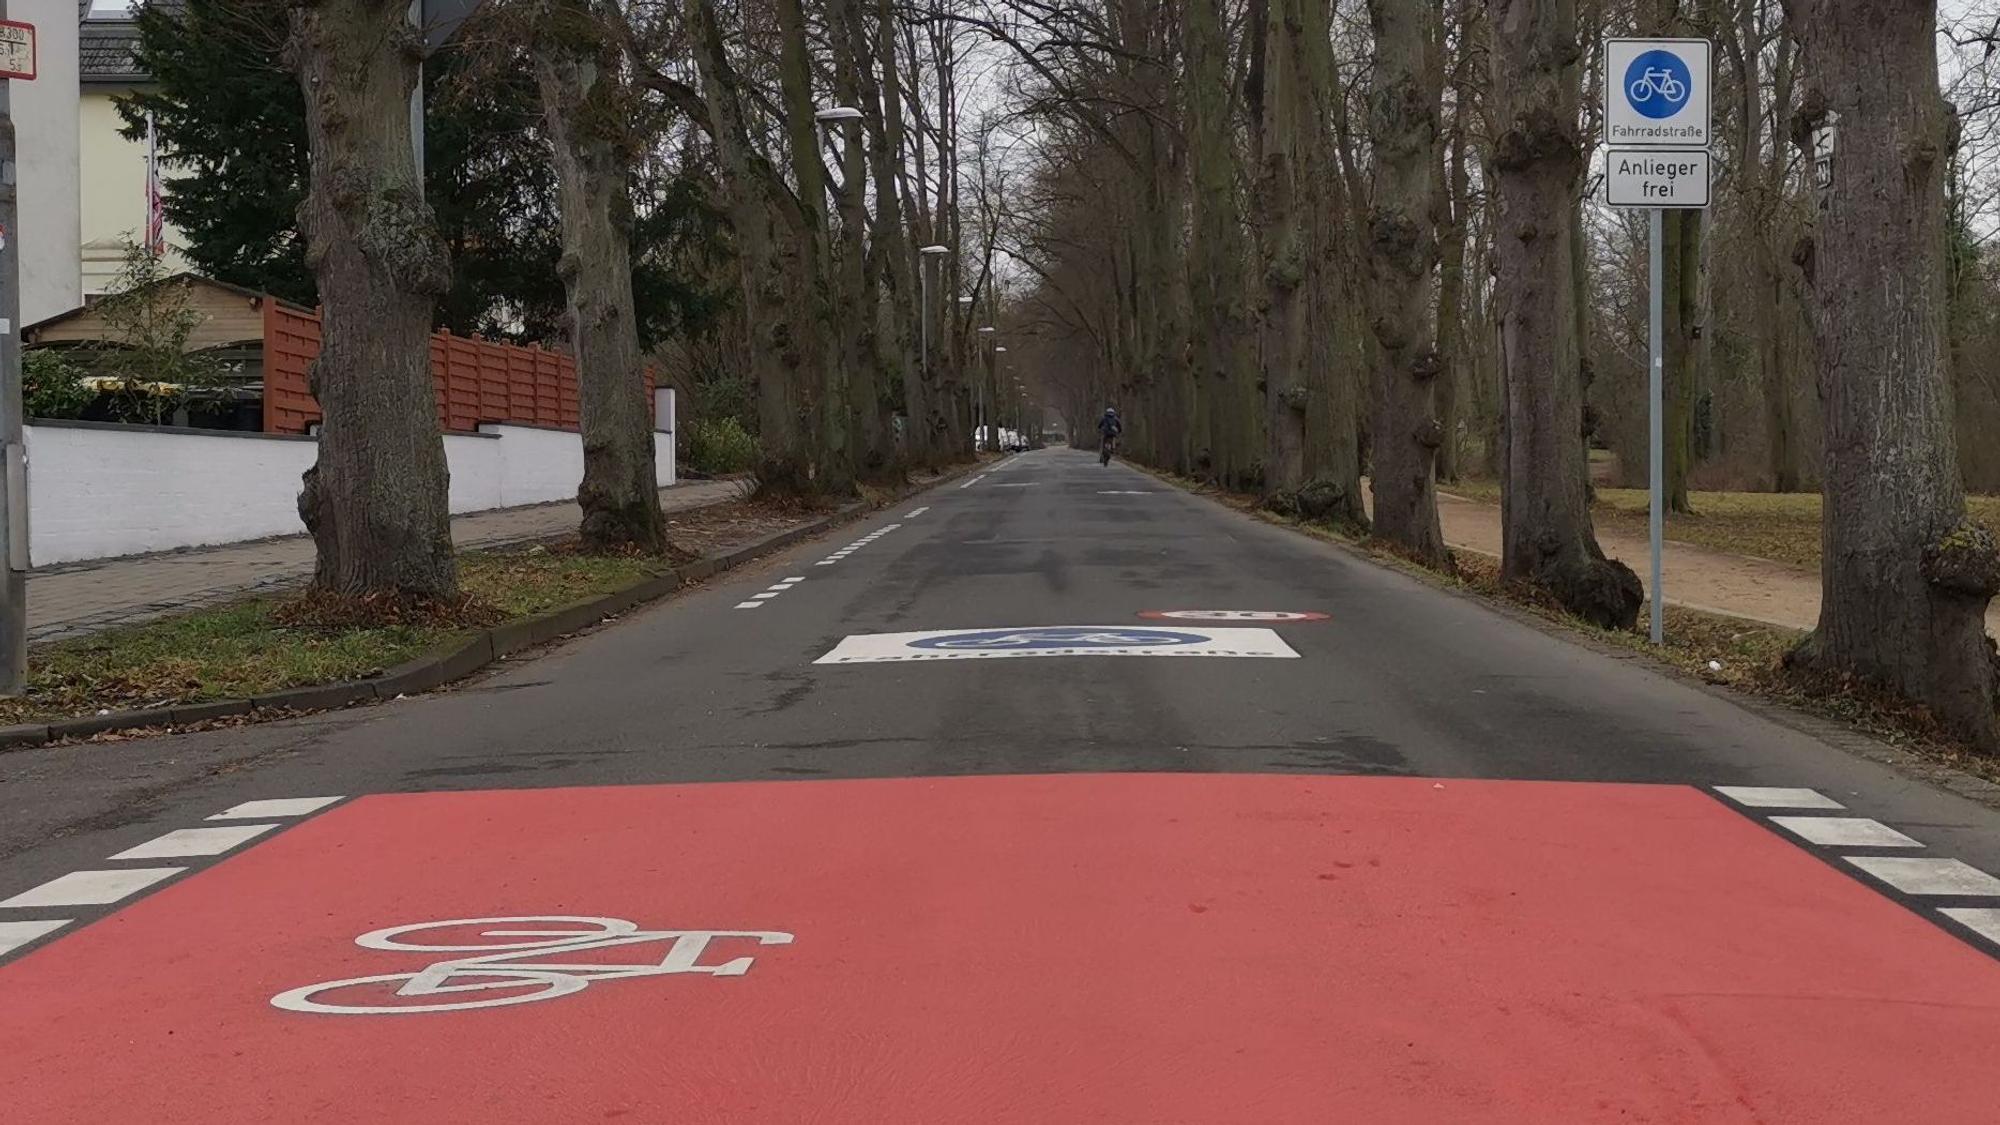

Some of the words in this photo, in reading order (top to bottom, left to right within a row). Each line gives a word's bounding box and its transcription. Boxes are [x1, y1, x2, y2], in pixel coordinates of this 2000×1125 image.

[1612, 125, 1703, 137] Fahrradstraße
[1619, 159, 1698, 180] Anlieger
[1642, 181, 1674, 197] frei
